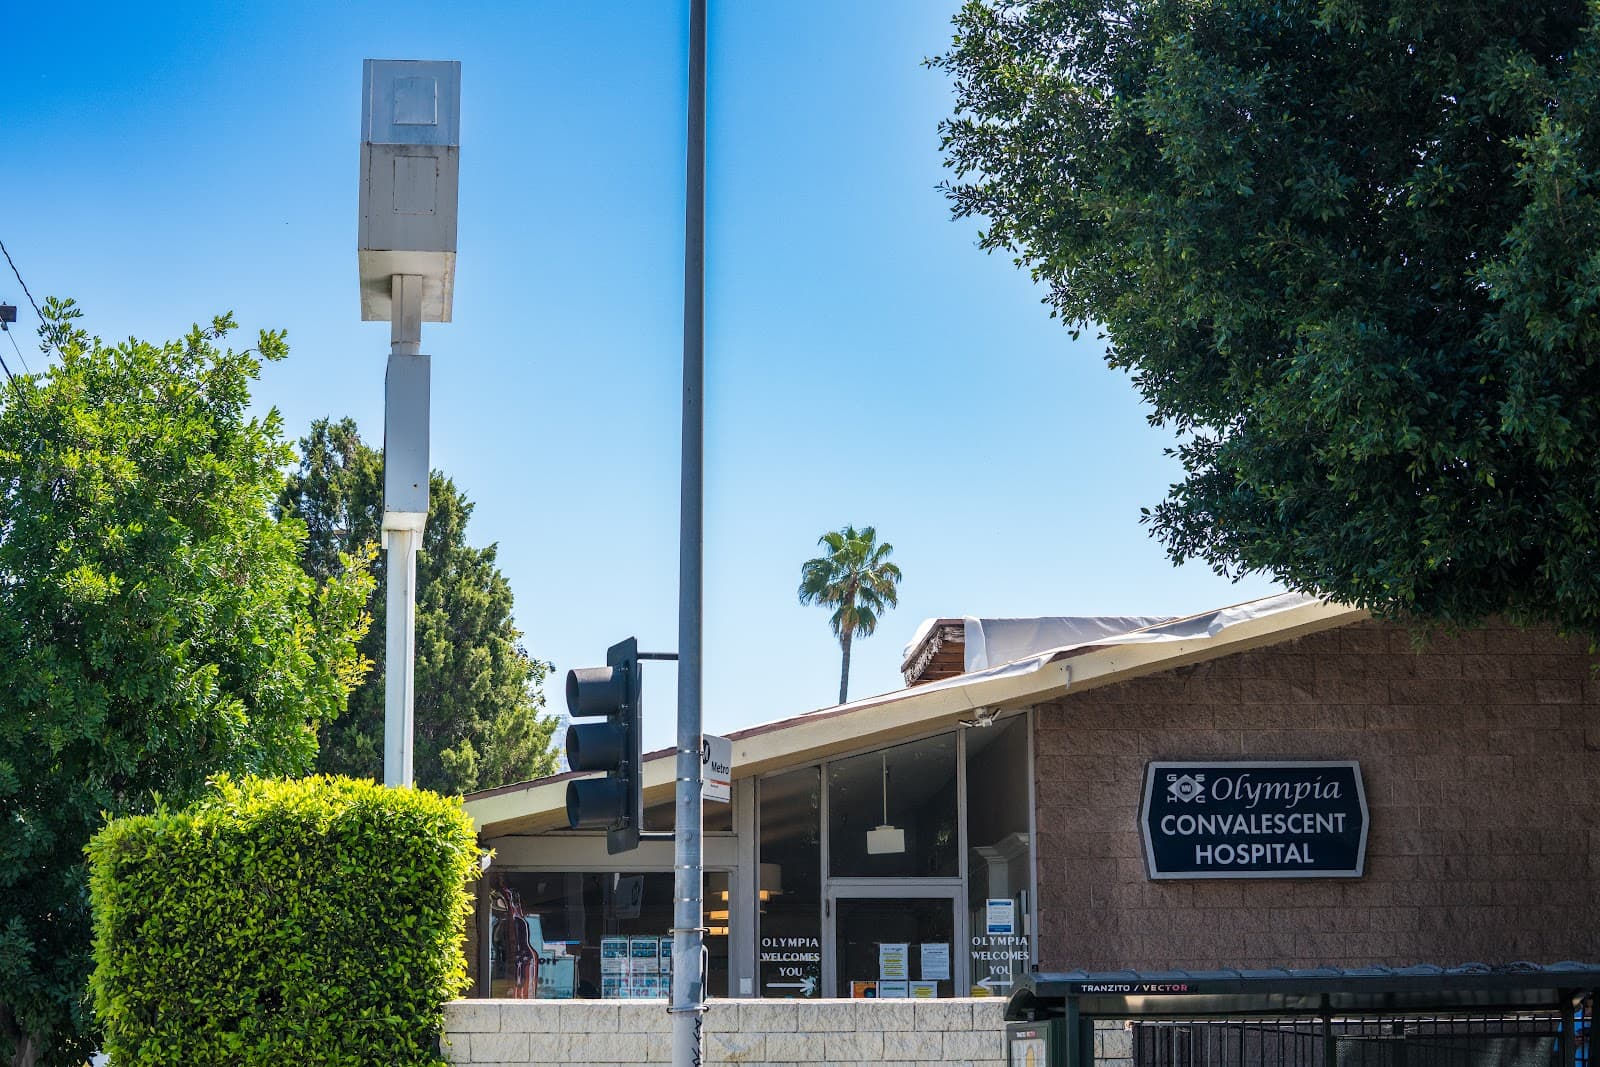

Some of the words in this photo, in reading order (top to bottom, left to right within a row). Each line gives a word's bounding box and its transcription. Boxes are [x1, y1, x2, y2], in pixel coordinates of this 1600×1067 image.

[711, 761, 730, 775] Metro
[1211, 773, 1341, 808] Olympia
[1161, 812, 1346, 835] CONVALESCENT
[1195, 843, 1315, 865] HOSPITAL
[761, 937, 819, 947] OLYMPIA
[971, 936, 1028, 946] OLYMPIA
[761, 952, 820, 961] WELCOMES
[971, 951, 1029, 960] WELCOMES
[779, 967, 803, 977] YOU
[989, 965, 1012, 975] YOU
[1081, 984, 1130, 992] TRANZITO
[1142, 984, 1188, 992] VECTOR
